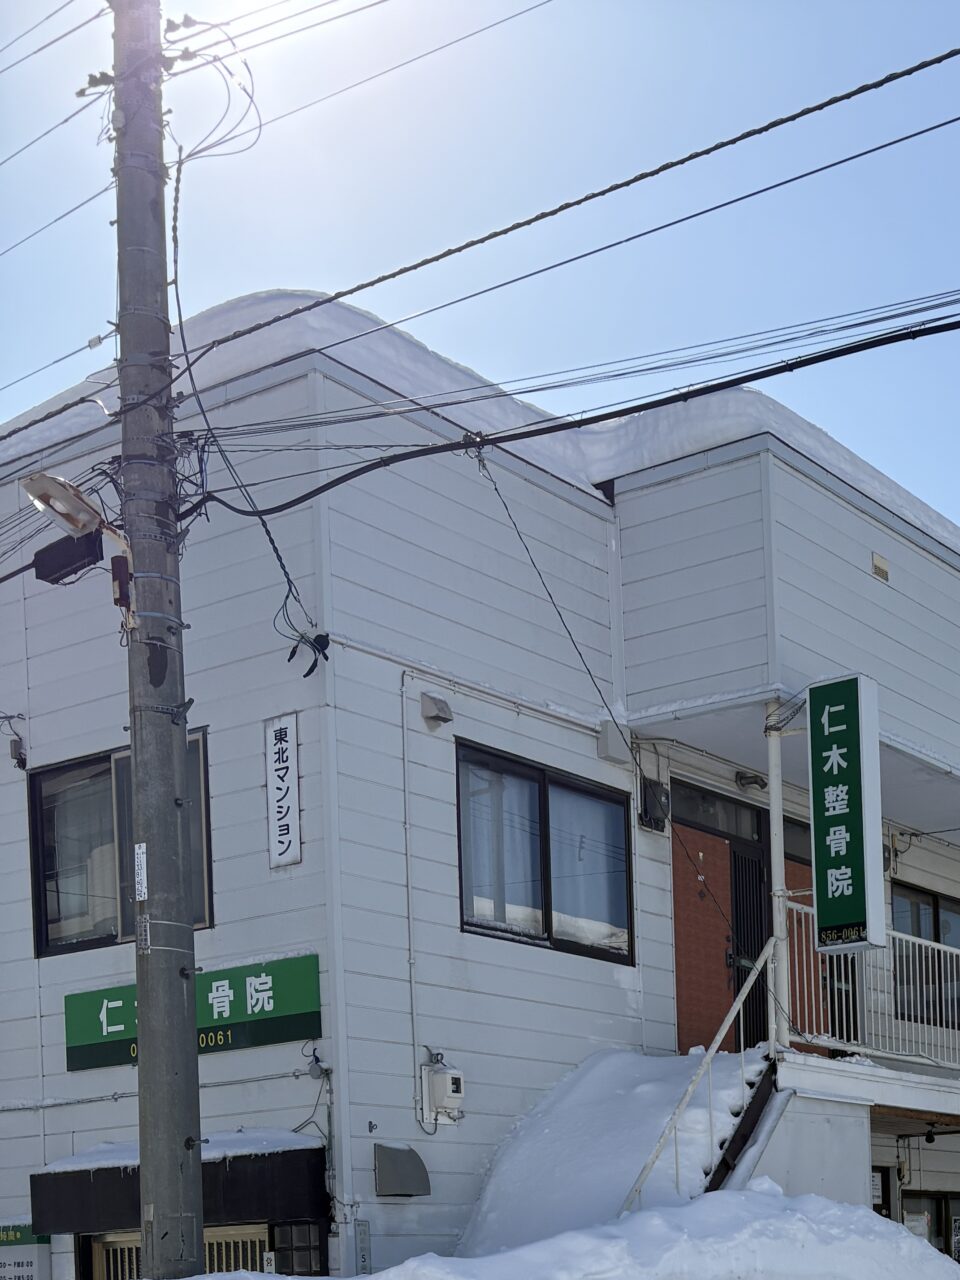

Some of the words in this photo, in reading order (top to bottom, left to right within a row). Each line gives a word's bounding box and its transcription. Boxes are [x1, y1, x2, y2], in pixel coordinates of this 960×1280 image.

[273, 727, 291, 856] 東北マンション
[821, 704, 853, 898] 仁木整骨院
[821, 926, 864, 942] 856-0061
[99, 973, 274, 1036] 仁骨院
